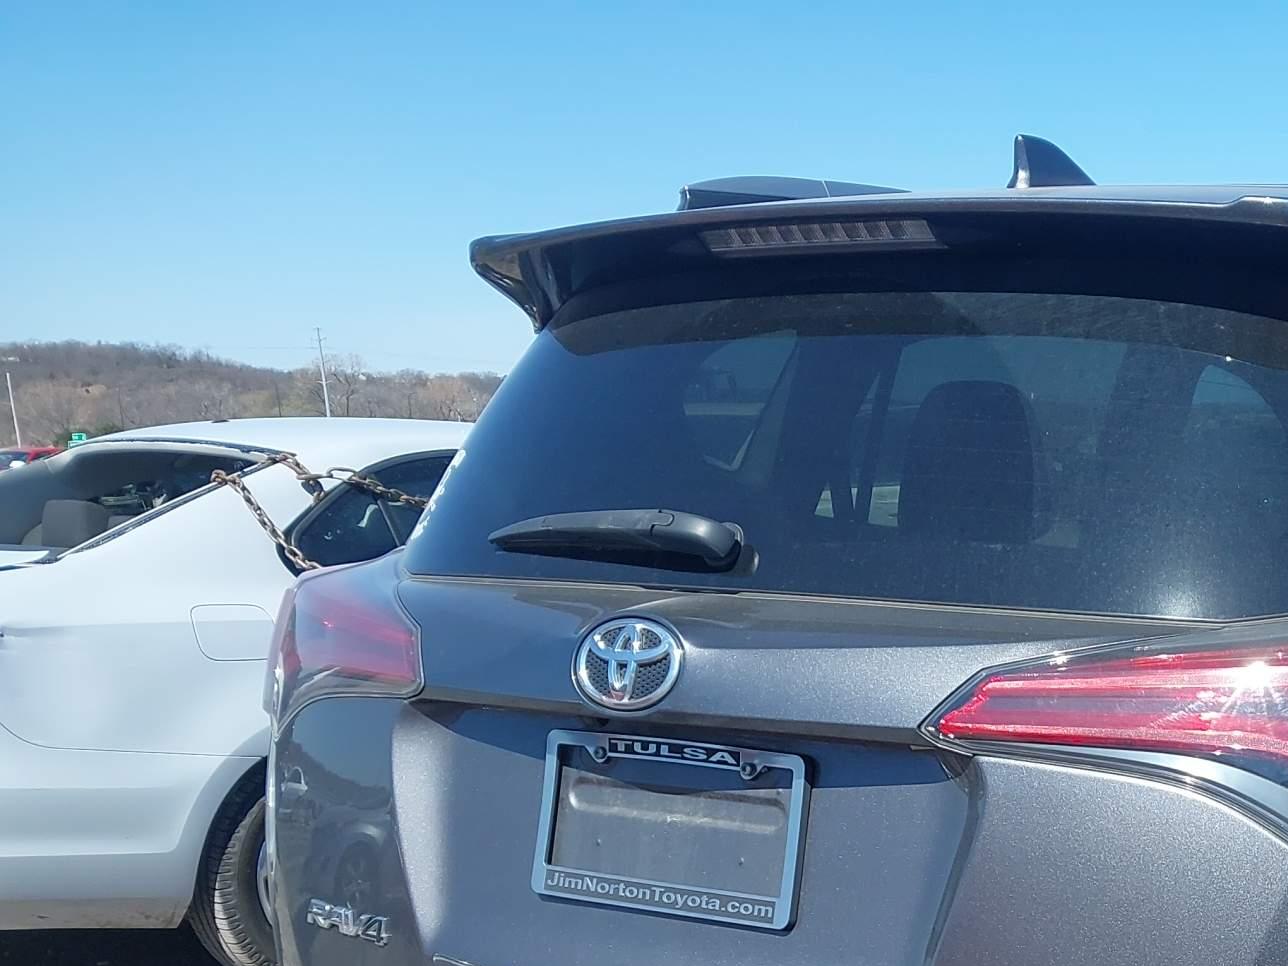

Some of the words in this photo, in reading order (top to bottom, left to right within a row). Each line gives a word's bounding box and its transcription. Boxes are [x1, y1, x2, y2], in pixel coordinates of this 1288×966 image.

[610, 739, 738, 765] TULSA
[548, 873, 774, 918] JimNortonToyota.com
[307, 897, 392, 947] RAV4
